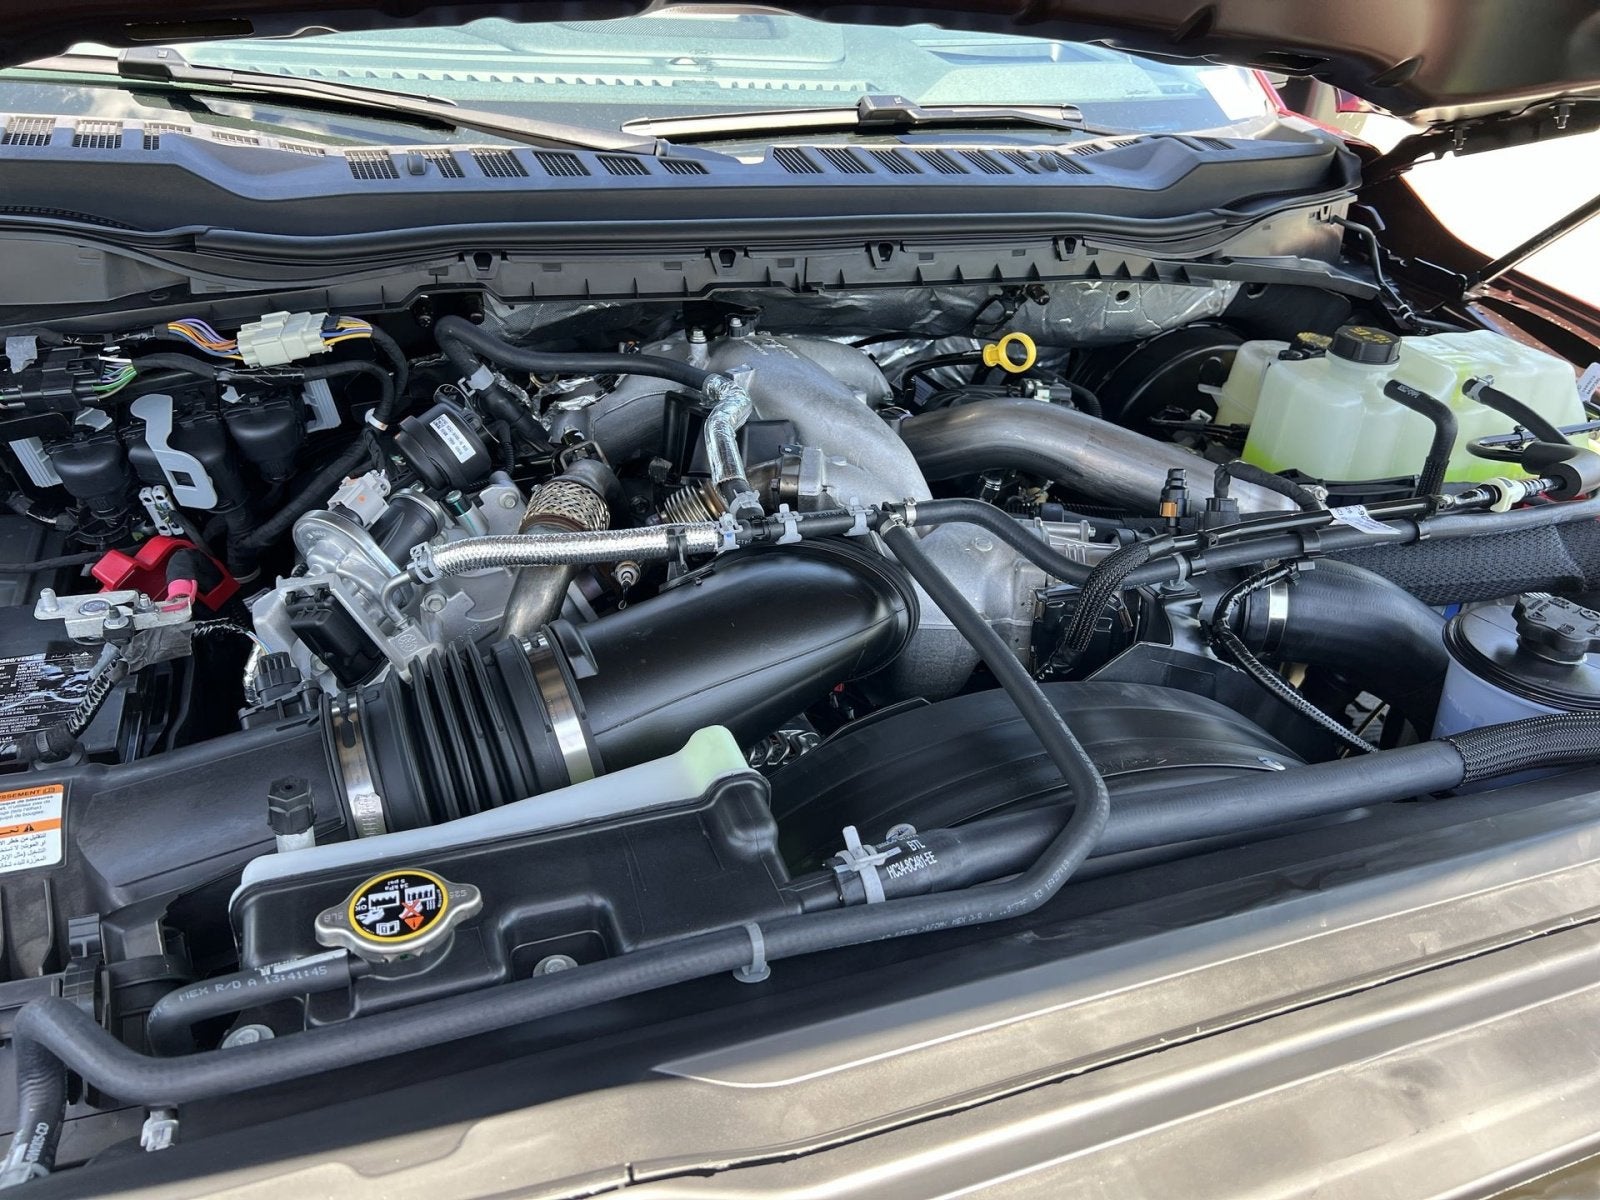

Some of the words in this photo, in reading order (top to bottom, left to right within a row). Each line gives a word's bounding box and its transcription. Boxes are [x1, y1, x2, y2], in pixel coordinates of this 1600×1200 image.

[0, 789, 41, 799] SSEMENT
[179, 987, 209, 1002] MEX
[264, 965, 328, 984] 13:41:45
